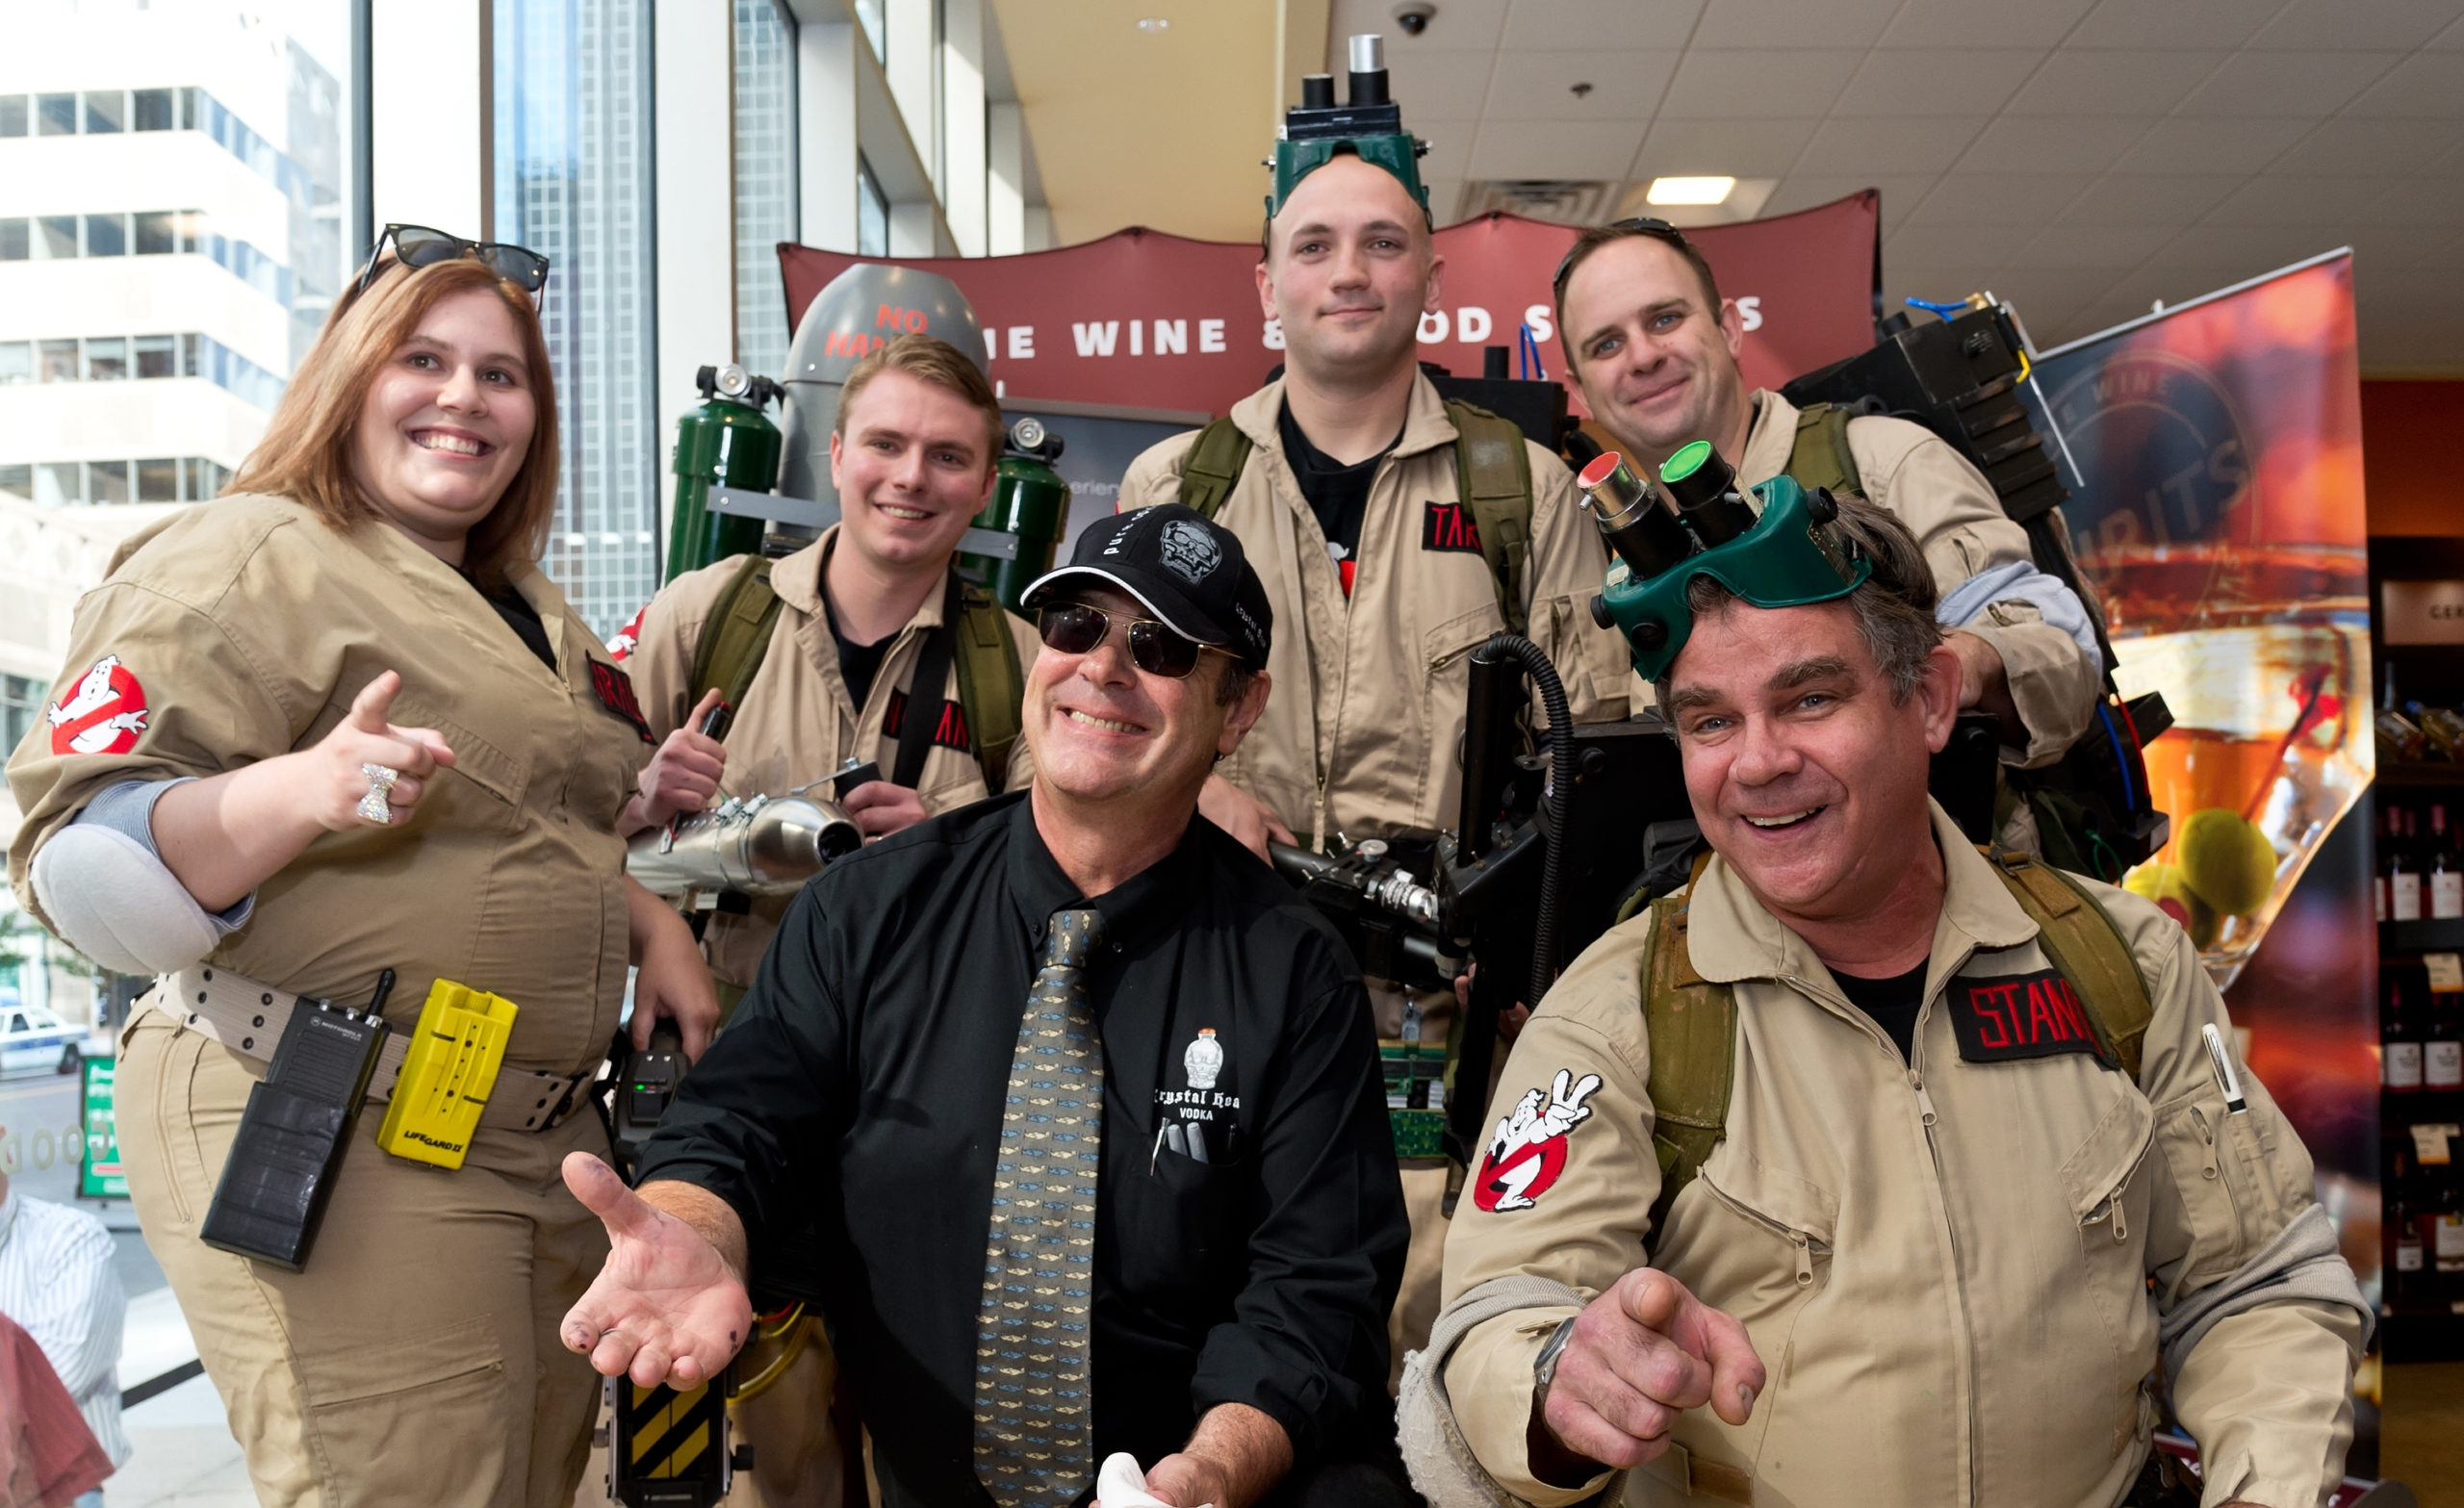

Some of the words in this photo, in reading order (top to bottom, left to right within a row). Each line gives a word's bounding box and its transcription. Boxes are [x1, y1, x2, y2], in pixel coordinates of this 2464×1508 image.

[876, 304, 929, 334] NO
[1072, 319, 1226, 357] WINE
[1416, 306, 1493, 345] OD
[1969, 978, 2098, 1050] STAN
[1212, 1091, 1240, 1110] Hea
[1179, 1107, 1214, 1121] VODKA
[403, 1130, 452, 1150] LIFEGARD
